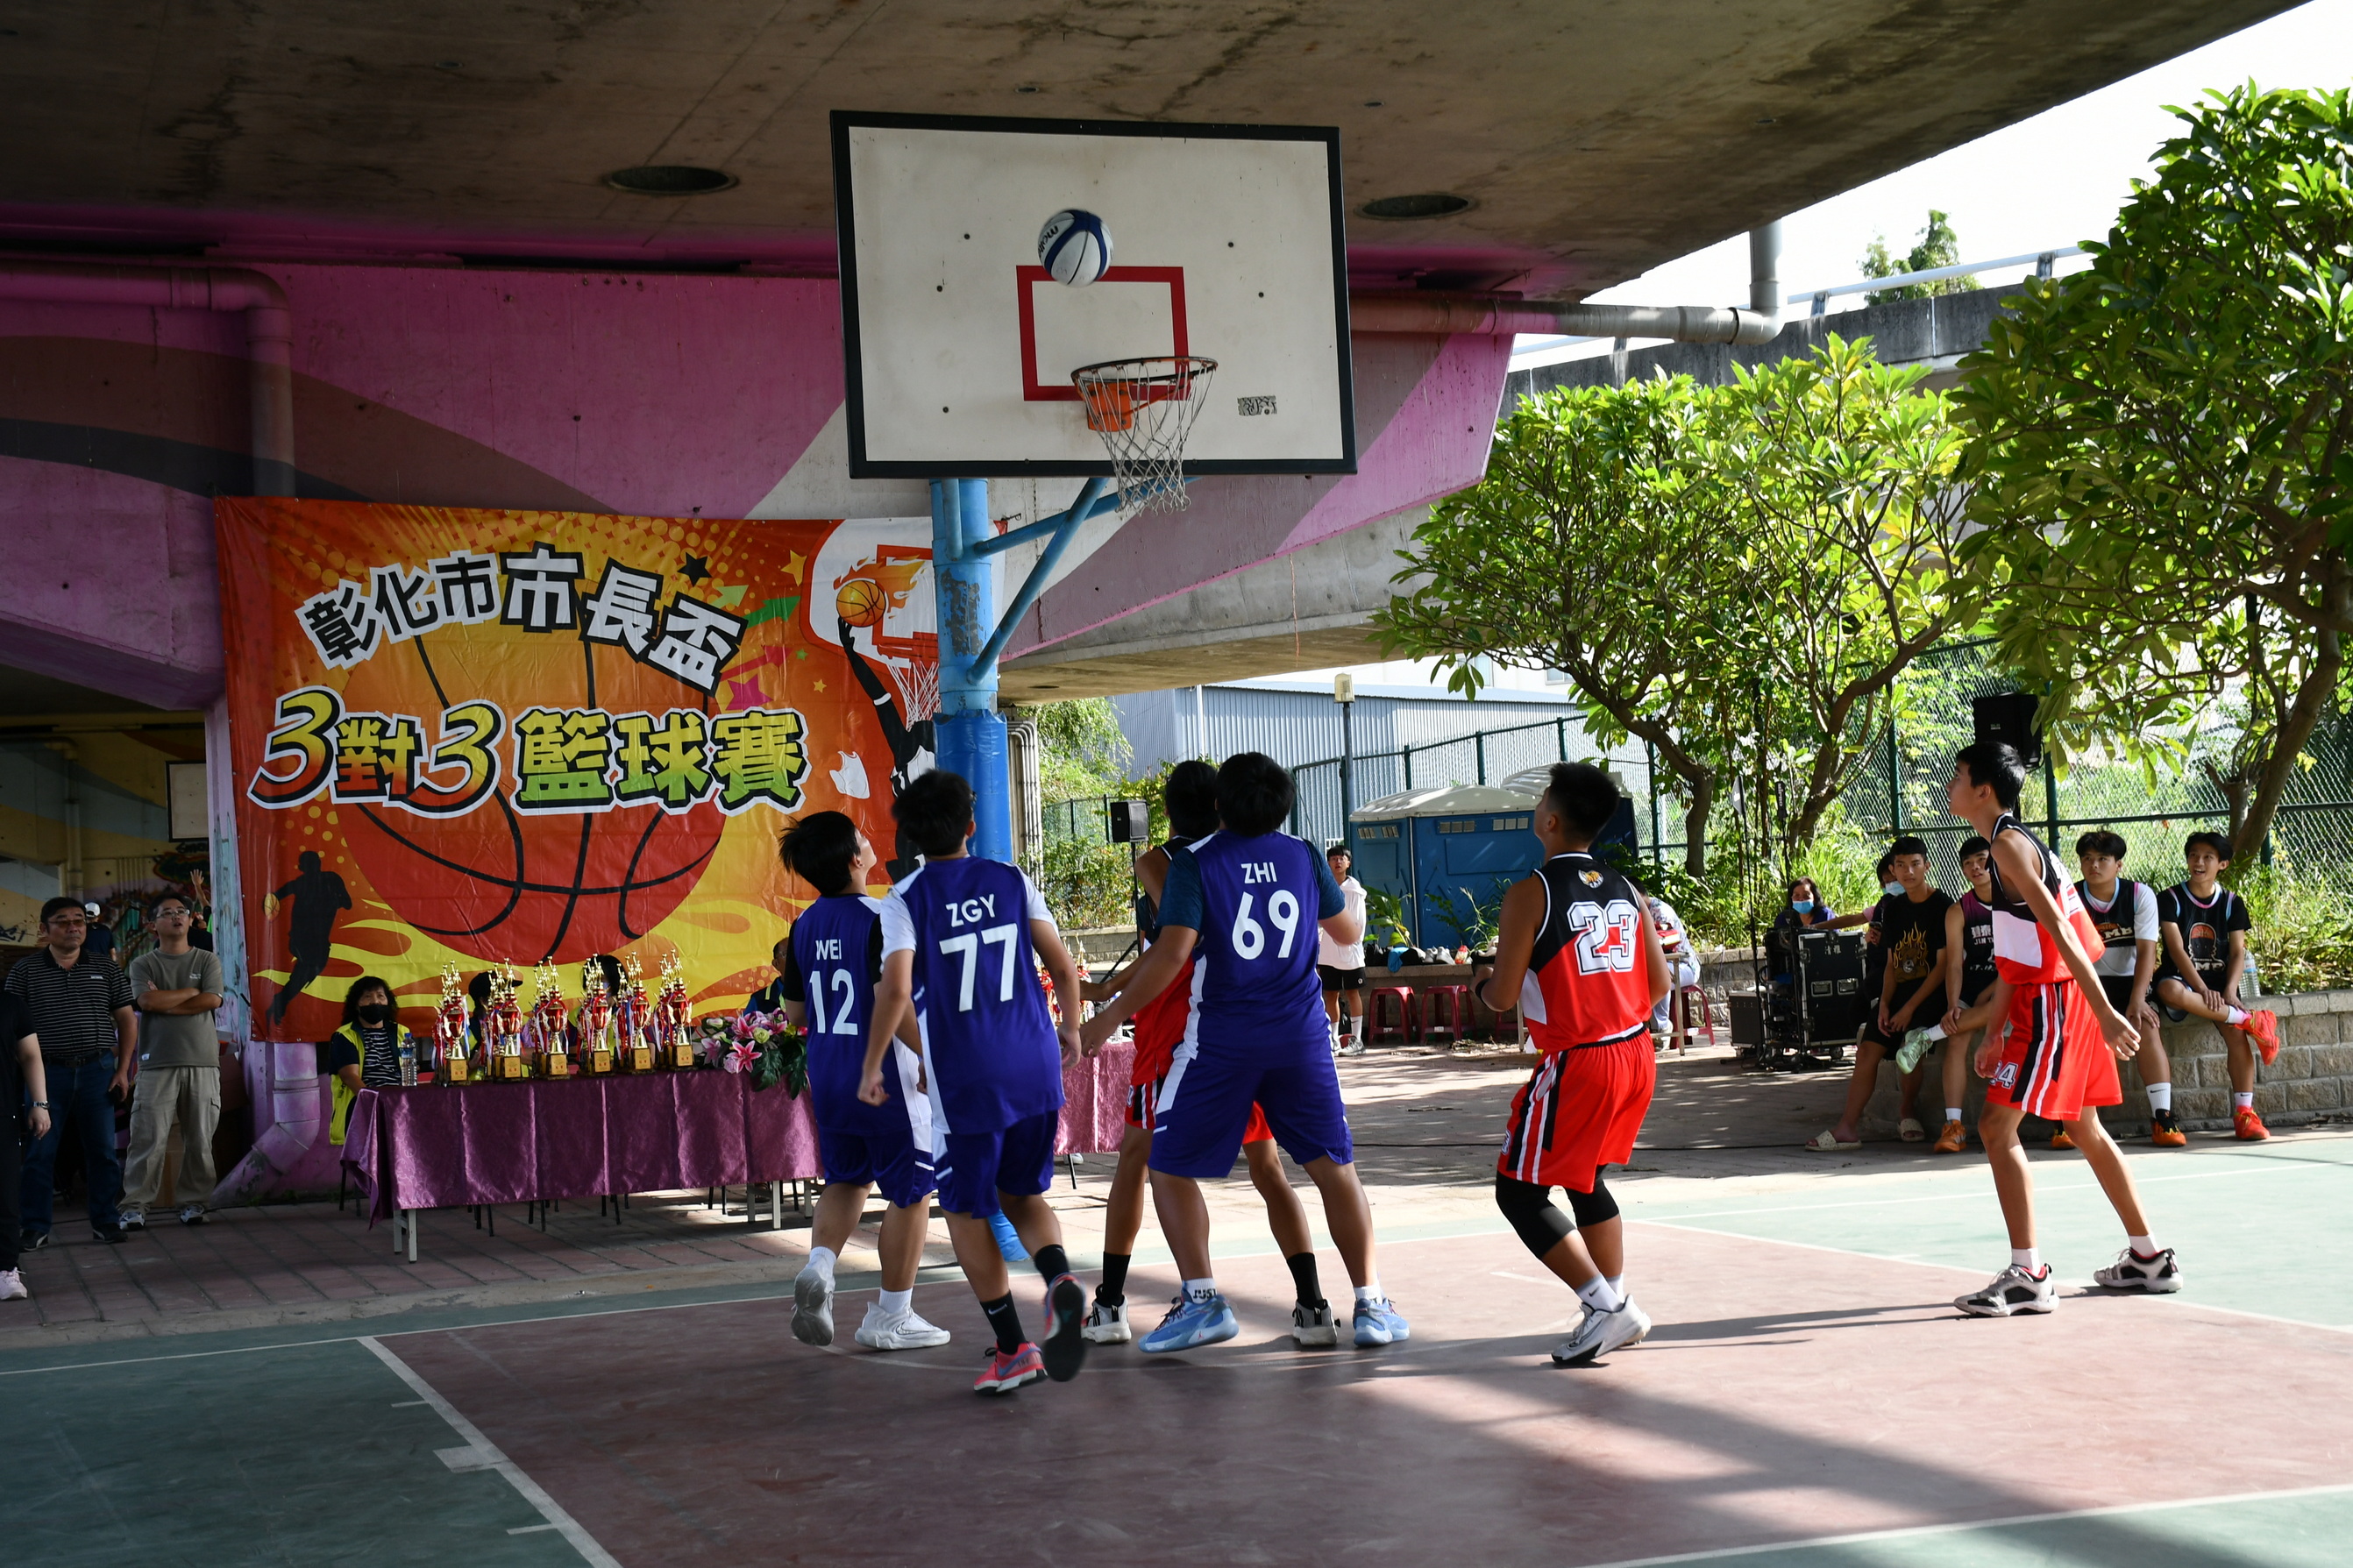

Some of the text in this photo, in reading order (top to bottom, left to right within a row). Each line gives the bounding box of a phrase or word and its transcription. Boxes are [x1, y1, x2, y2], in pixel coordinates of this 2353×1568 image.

[296, 542, 748, 695] 彰化市市長盃
[1240, 862, 1277, 884] ZHI
[945, 893, 995, 927] ZGY
[1232, 889, 1300, 961] 69
[1567, 899, 1639, 976] 23
[815, 939, 842, 961] WEI
[939, 922, 1019, 1012] 77
[809, 968, 858, 1036] 12
